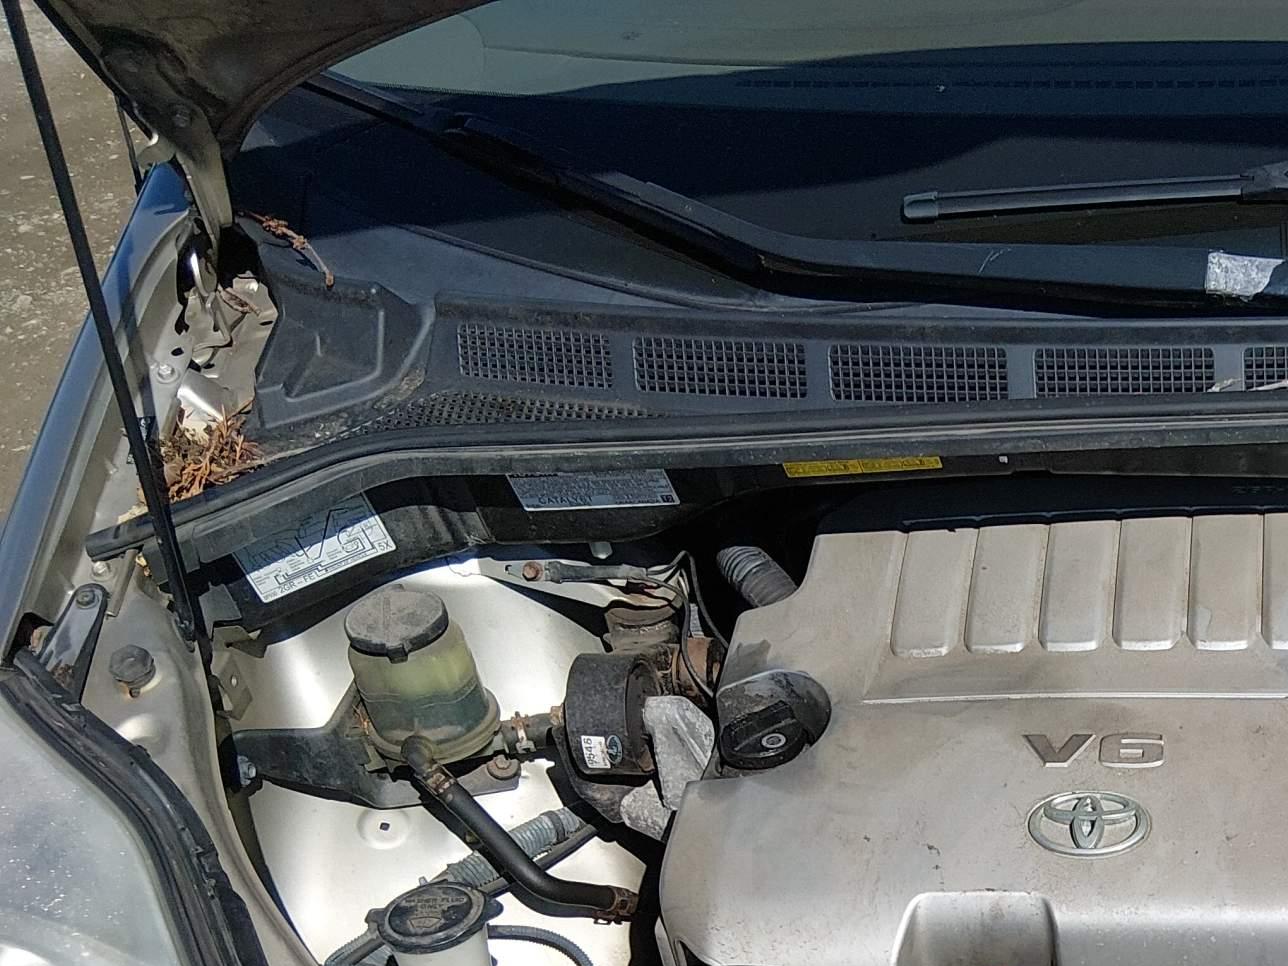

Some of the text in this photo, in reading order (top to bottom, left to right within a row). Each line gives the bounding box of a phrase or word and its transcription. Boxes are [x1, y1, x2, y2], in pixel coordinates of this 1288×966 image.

[378, 540, 393, 552] 5X
[278, 580, 297, 594] 2GR
[302, 571, 317, 583] FE
[1022, 733, 1165, 769] V6
